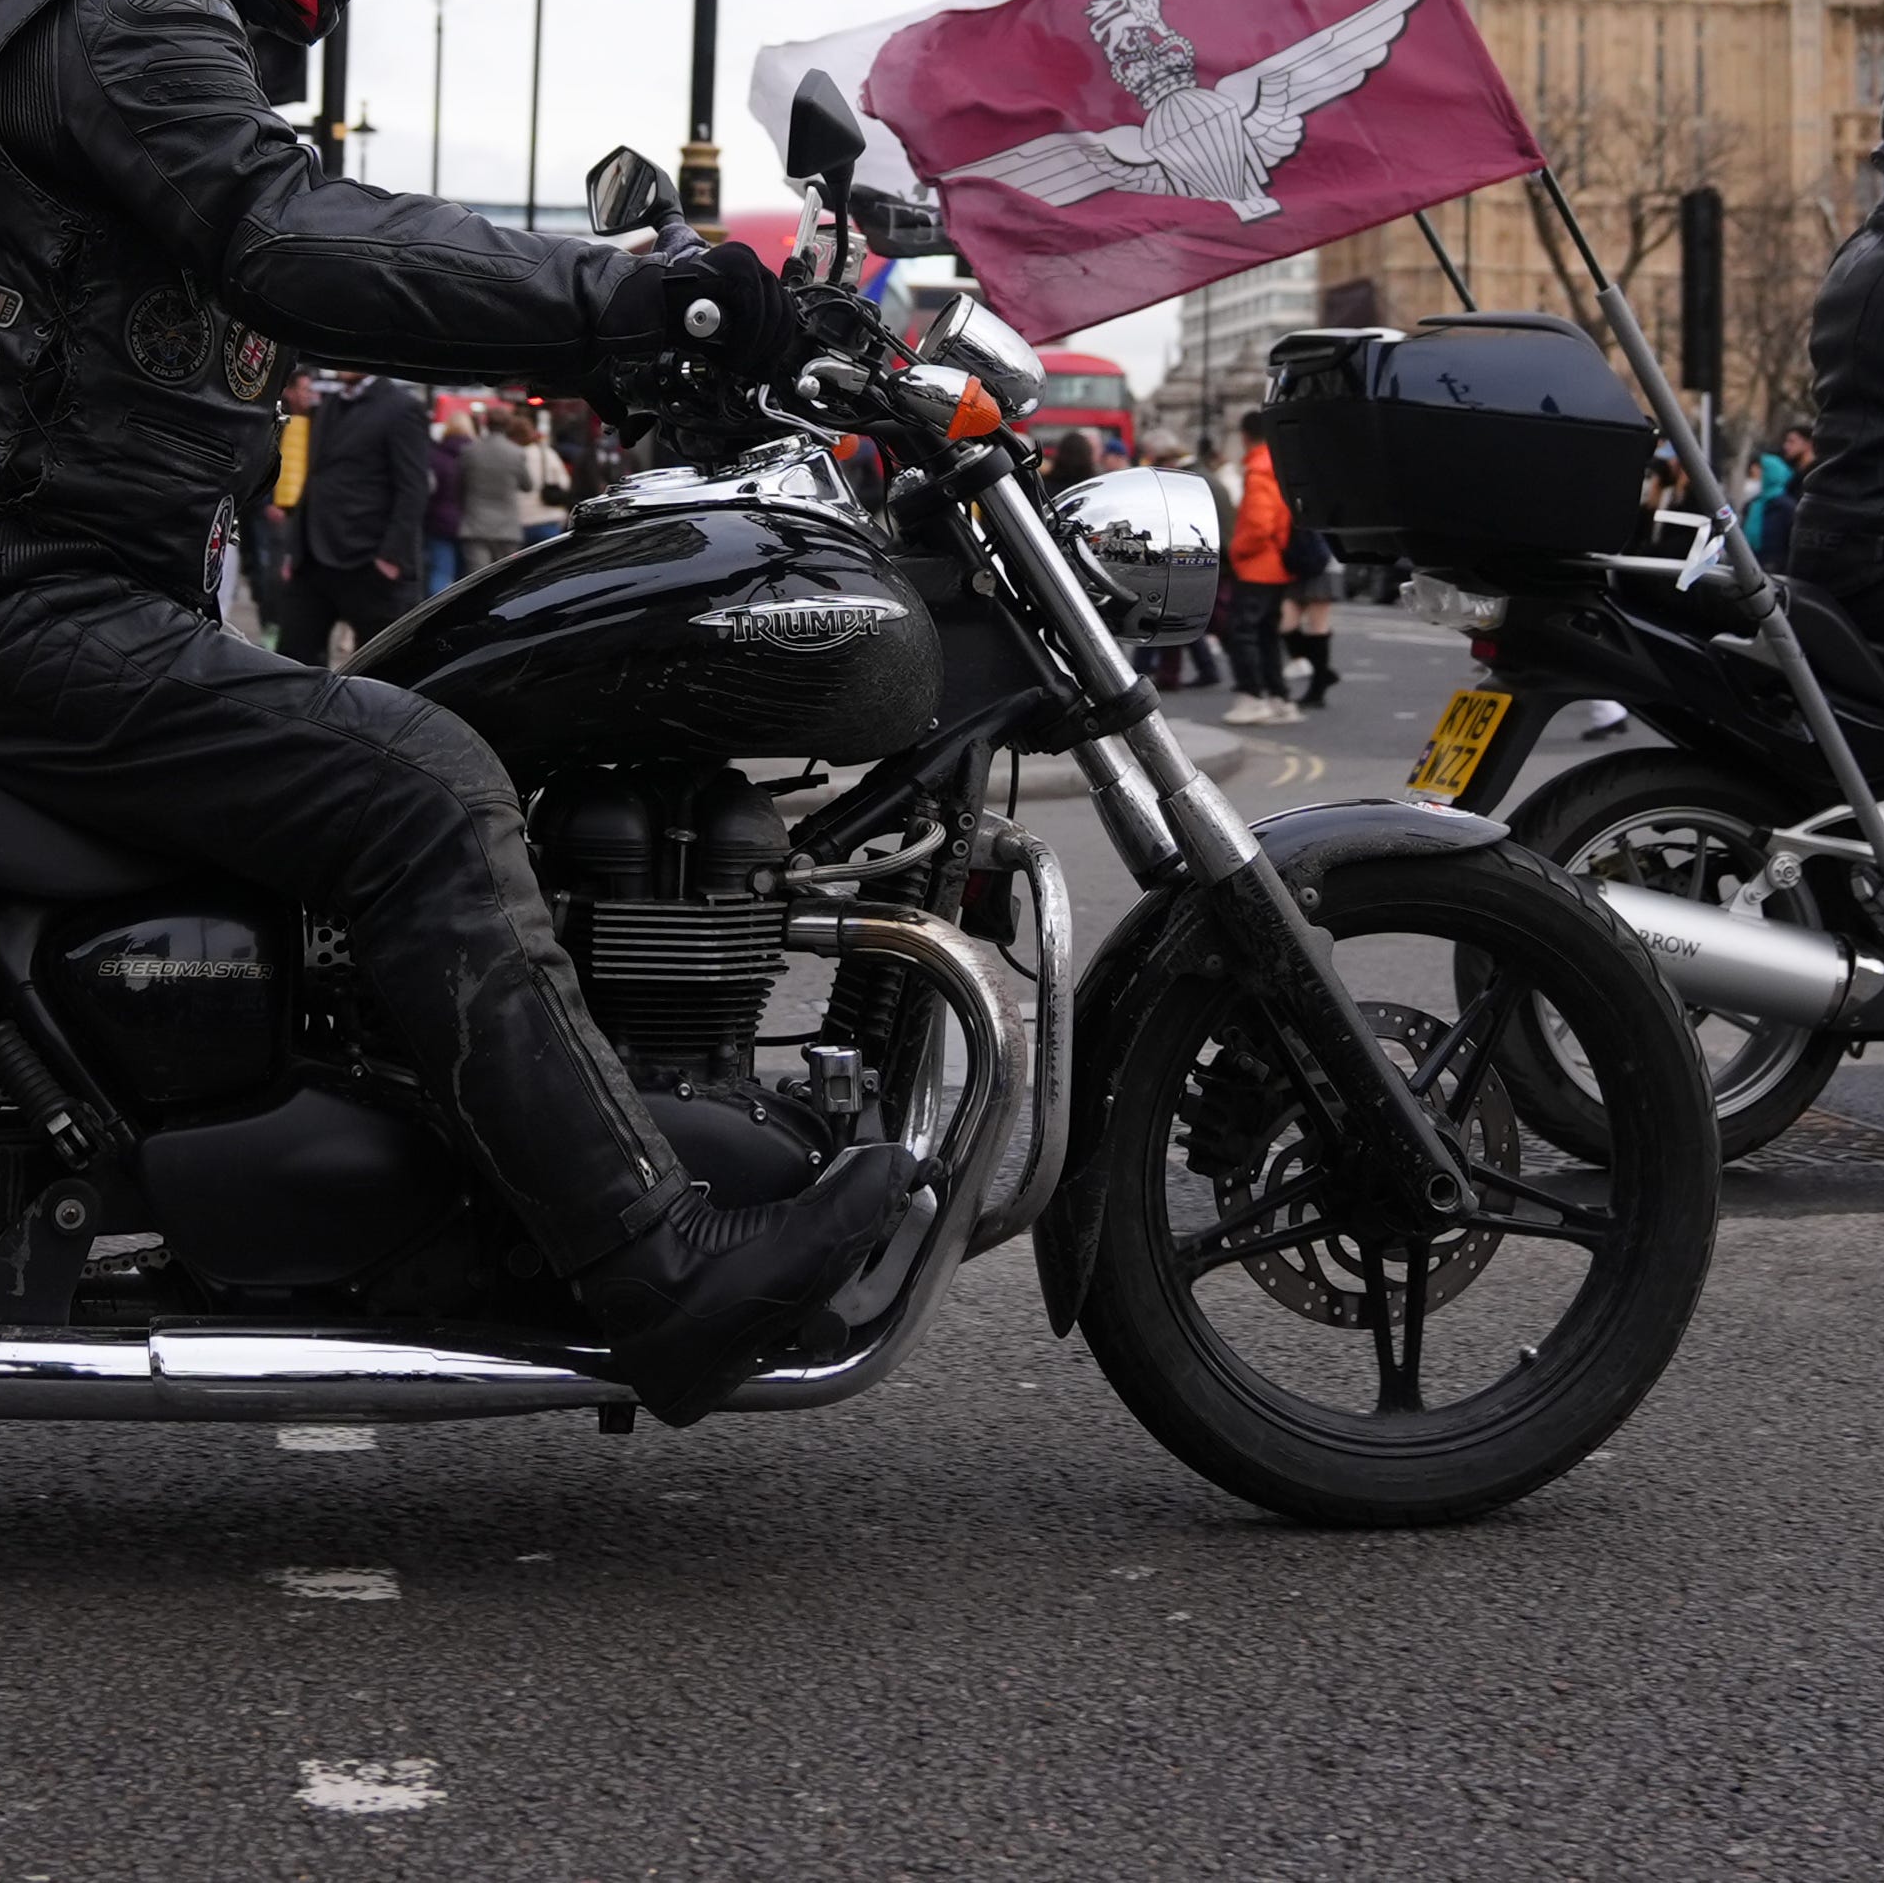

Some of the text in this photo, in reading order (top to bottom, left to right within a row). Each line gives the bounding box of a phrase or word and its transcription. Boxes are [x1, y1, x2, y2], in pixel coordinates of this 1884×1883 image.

[724, 608, 881, 646] TRIUMPH
[1638, 928, 1702, 958] RROW
[98, 960, 274, 980] SPEEDMASTER
